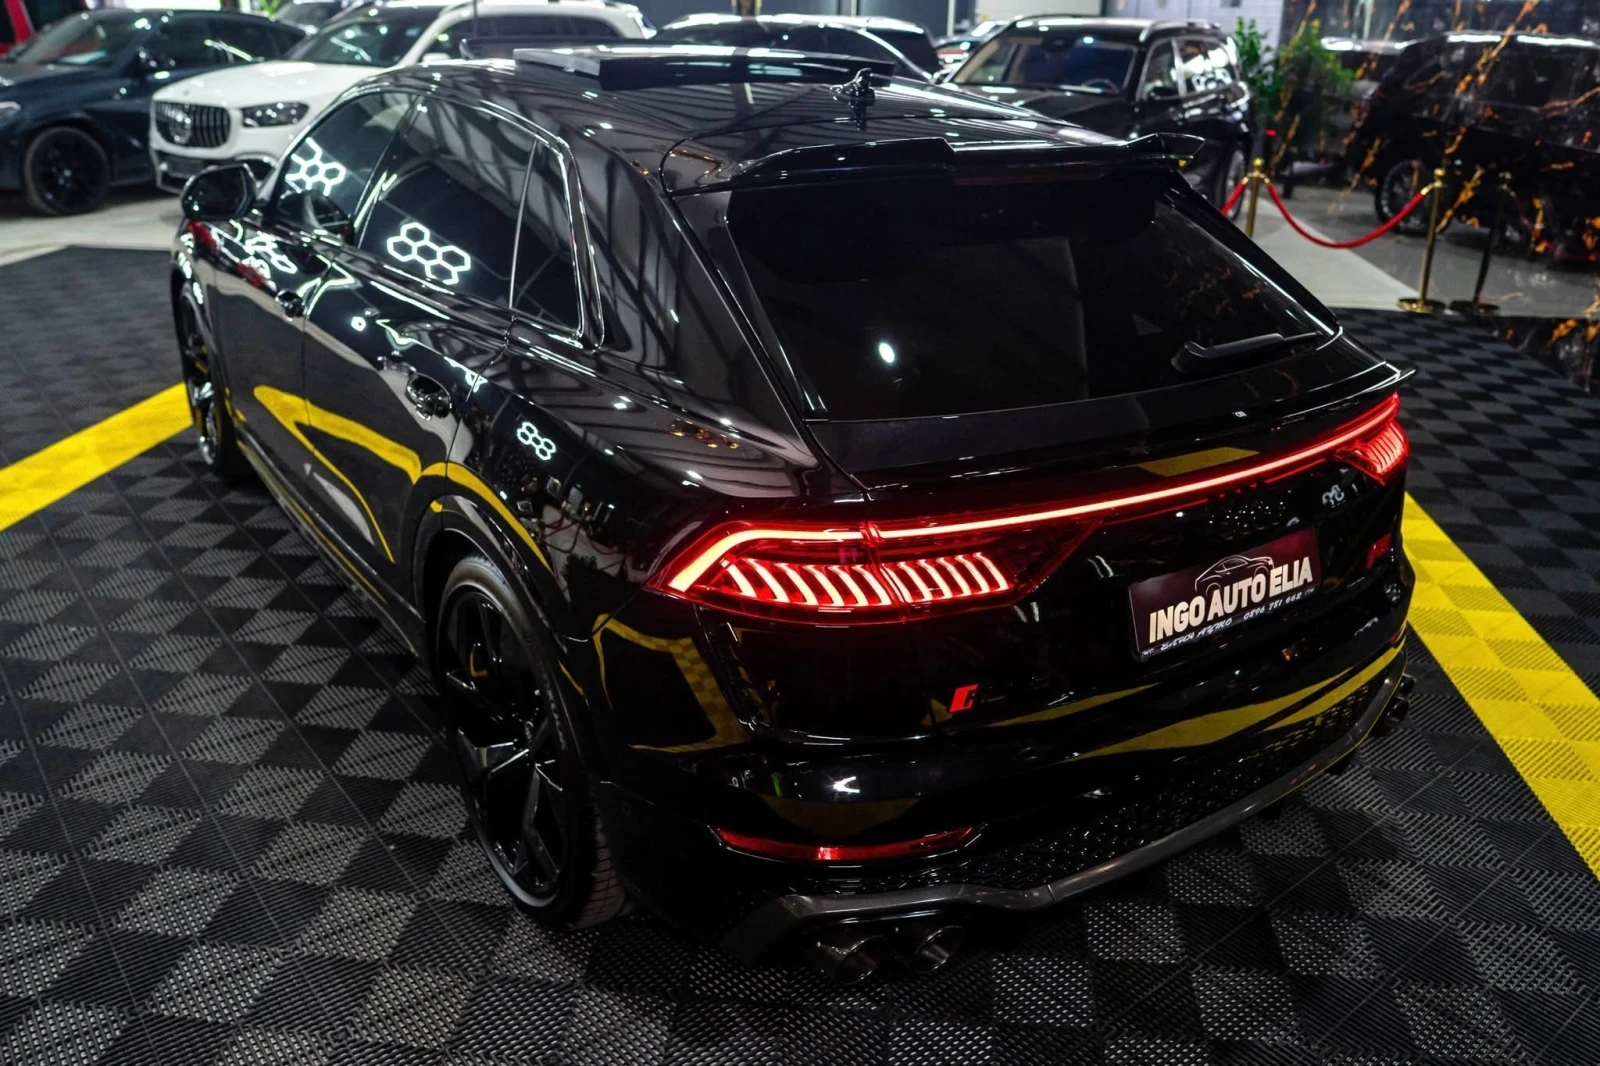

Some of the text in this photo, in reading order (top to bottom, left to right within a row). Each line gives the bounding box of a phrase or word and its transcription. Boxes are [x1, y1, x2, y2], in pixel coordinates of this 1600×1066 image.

[1149, 556, 1313, 643] INGO AUTO ELIA
[1243, 605, 1266, 621] 0896
